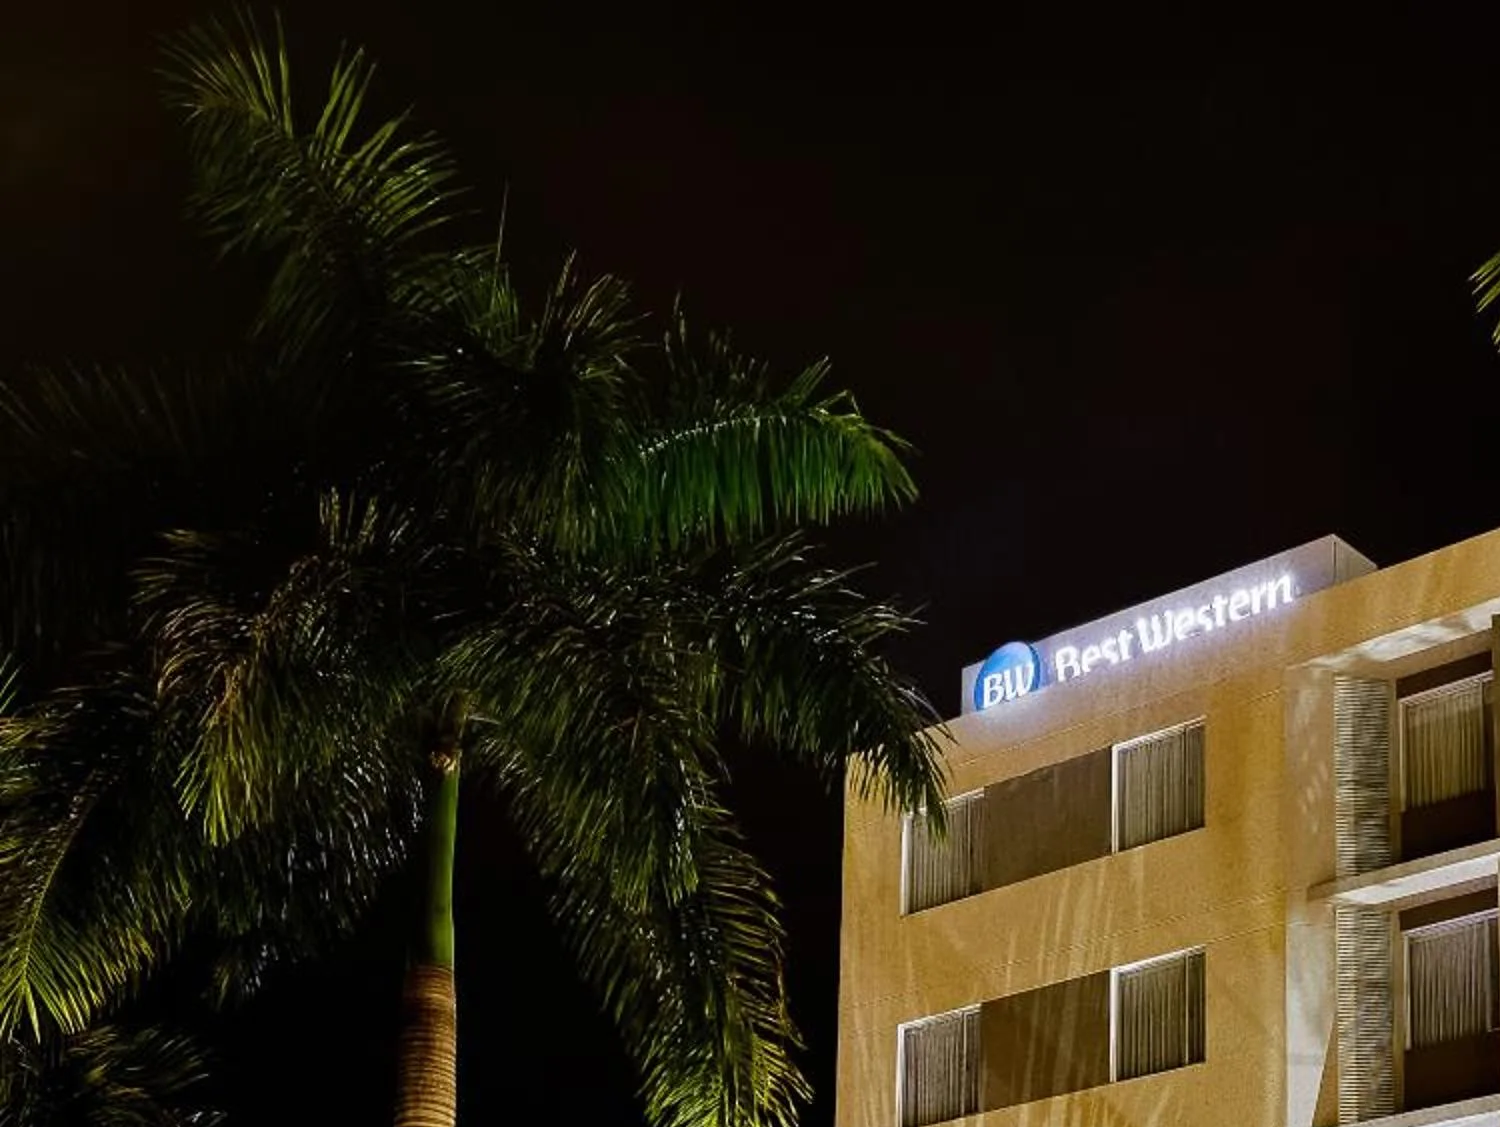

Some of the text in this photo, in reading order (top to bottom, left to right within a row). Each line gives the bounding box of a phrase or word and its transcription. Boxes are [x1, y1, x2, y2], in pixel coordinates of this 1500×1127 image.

[1055, 572, 1294, 682] Best Western
[982, 661, 1034, 711] BW
